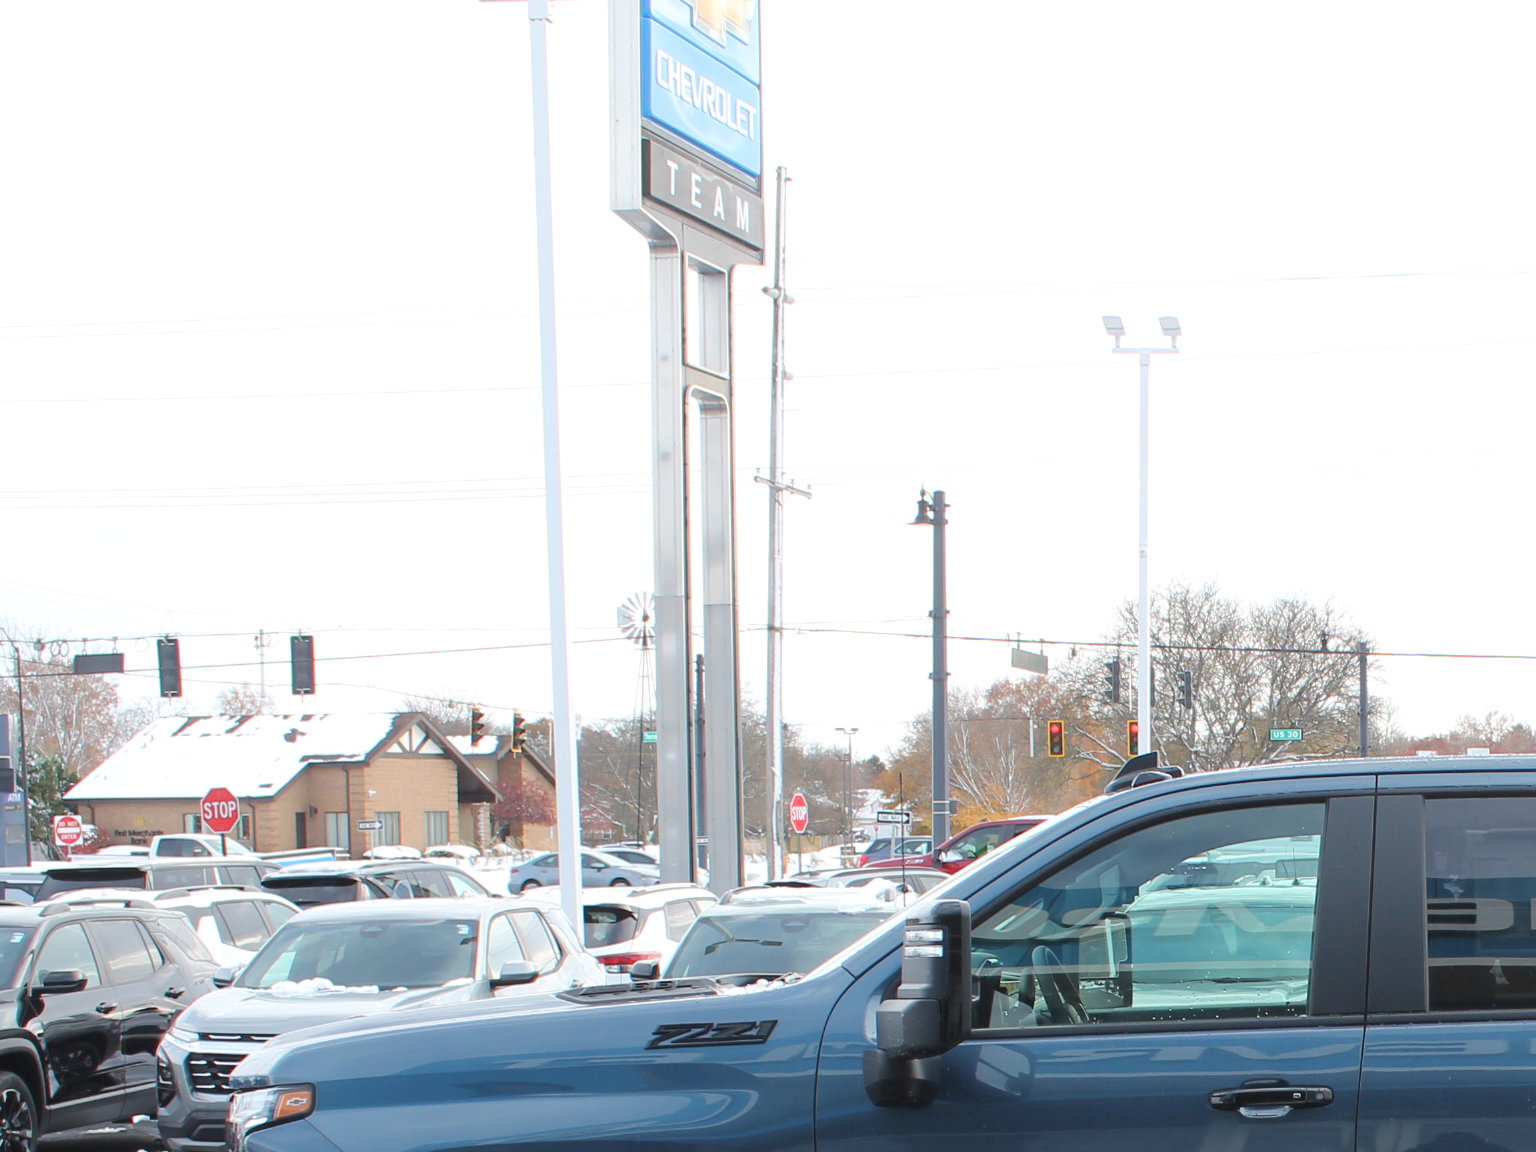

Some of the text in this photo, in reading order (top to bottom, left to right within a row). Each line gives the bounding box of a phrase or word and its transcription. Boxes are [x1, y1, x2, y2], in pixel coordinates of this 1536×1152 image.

[656, 50, 756, 139] CHEVROLET
[667, 160, 749, 232] TEAM
[8, 793, 21, 802] ATM
[203, 801, 237, 820] STOP
[791, 807, 807, 820] STOP
[644, 1019, 778, 1050] Z71
